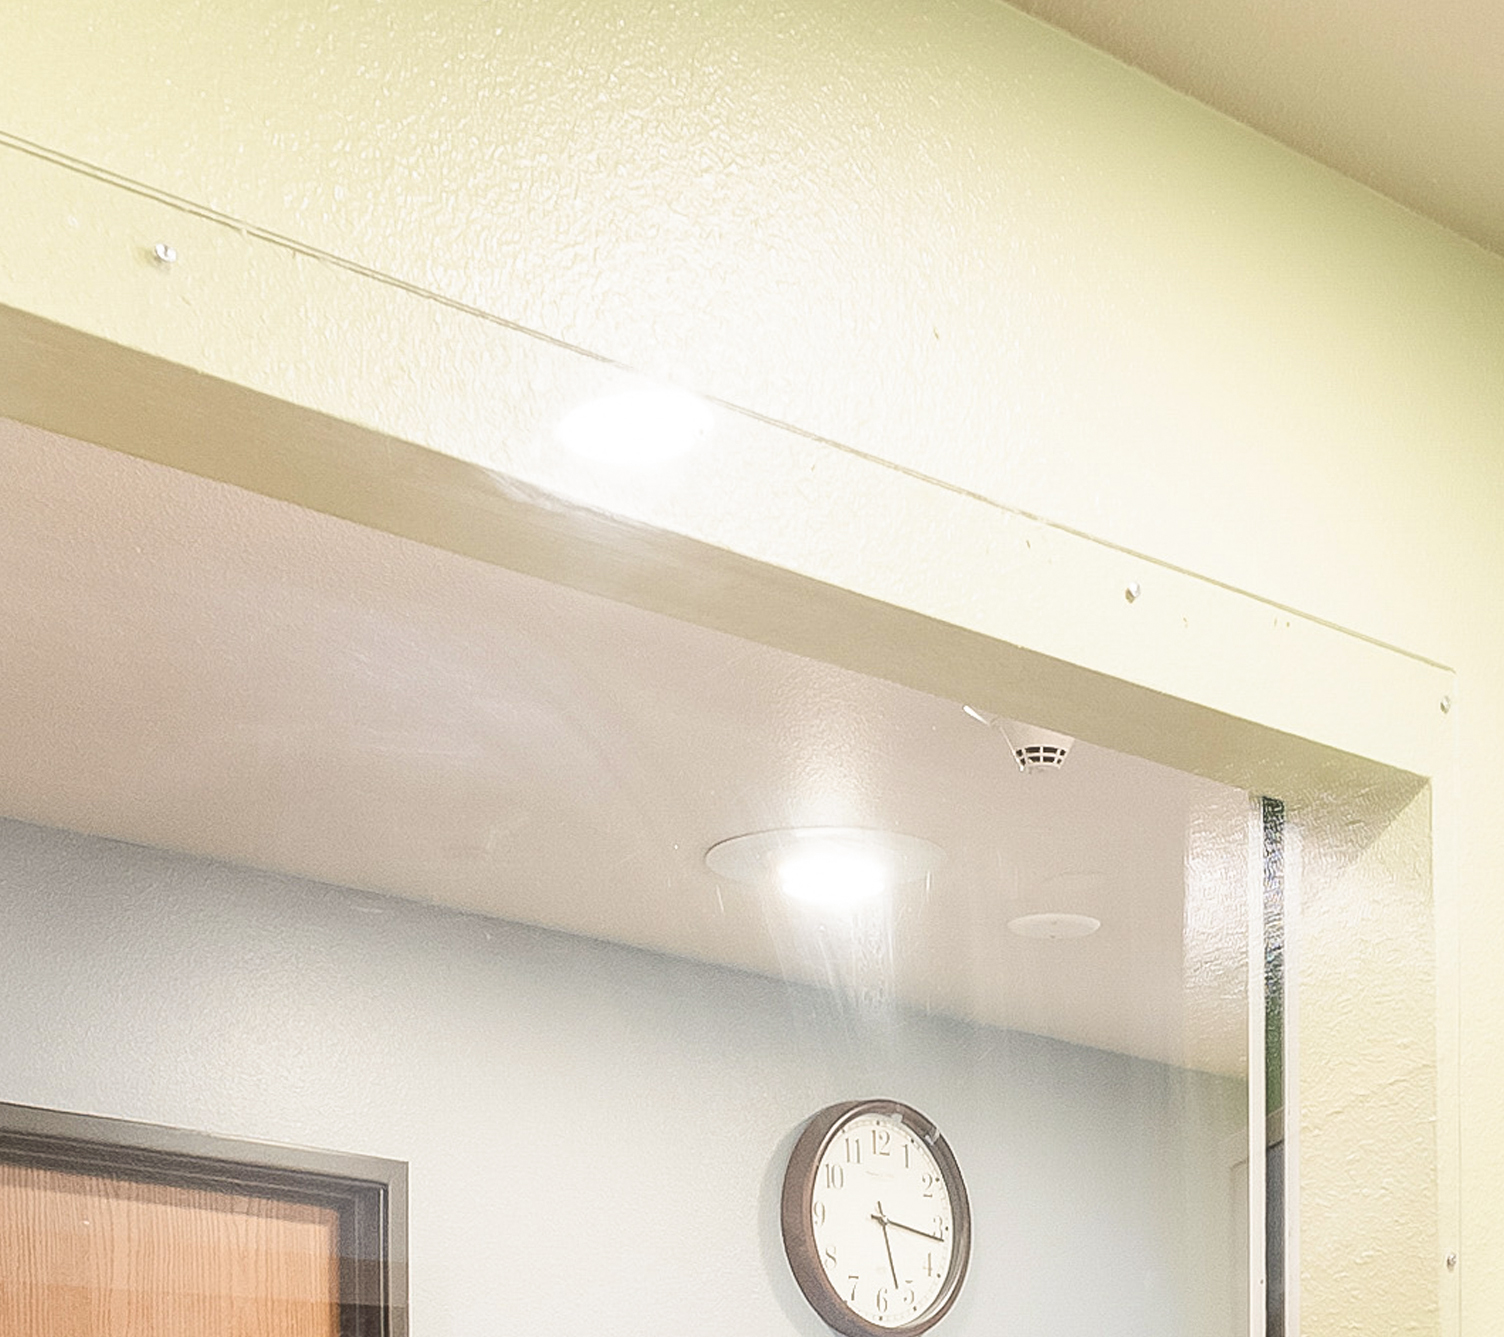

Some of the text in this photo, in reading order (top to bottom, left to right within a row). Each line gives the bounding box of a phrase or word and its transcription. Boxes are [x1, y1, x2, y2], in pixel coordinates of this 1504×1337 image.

[844, 1137, 861, 1164] 11
[871, 1129, 891, 1157] 12
[903, 1143, 910, 1169] 1
[825, 1163, 844, 1189] 10
[921, 1173, 934, 1198] 2
[813, 1200, 826, 1227] 9
[932, 1215, 944, 1240] 3
[824, 1246, 837, 1270] 8
[922, 1252, 933, 1278] 4
[848, 1275, 860, 1301] 7
[876, 1288, 889, 1313] 6
[902, 1280, 915, 1305] 5
